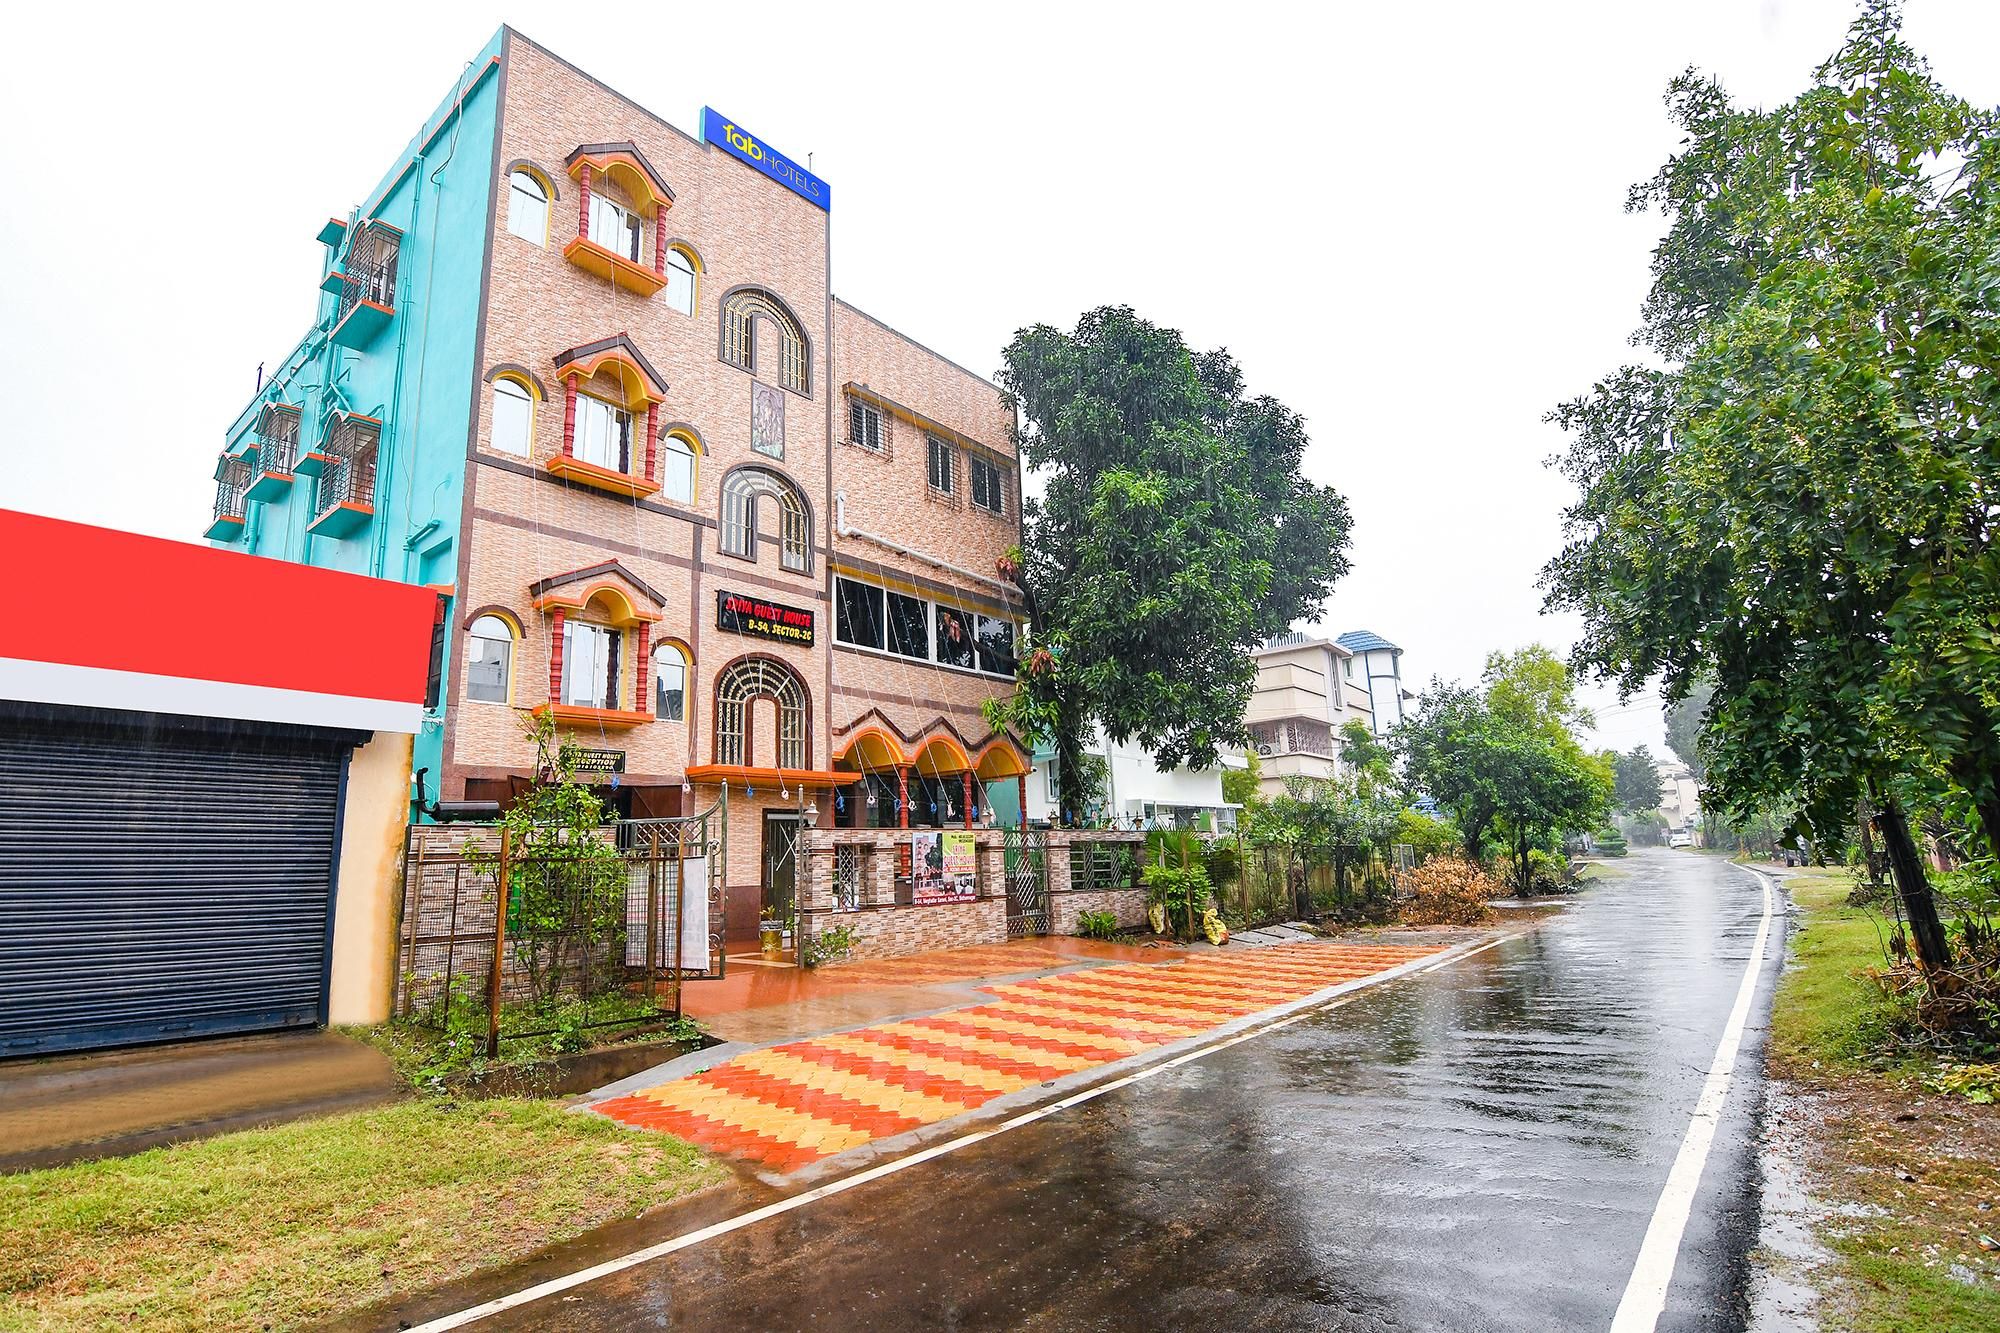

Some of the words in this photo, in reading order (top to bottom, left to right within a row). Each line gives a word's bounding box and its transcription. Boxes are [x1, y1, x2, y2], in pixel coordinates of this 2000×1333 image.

[754, 604, 782, 622] GUEST
[784, 610, 811, 626] HOUSE
[748, 619, 769, 634] B-54,
[771, 624, 812, 641] SECTOR-2C
[573, 757, 616, 765] ECEPTION
